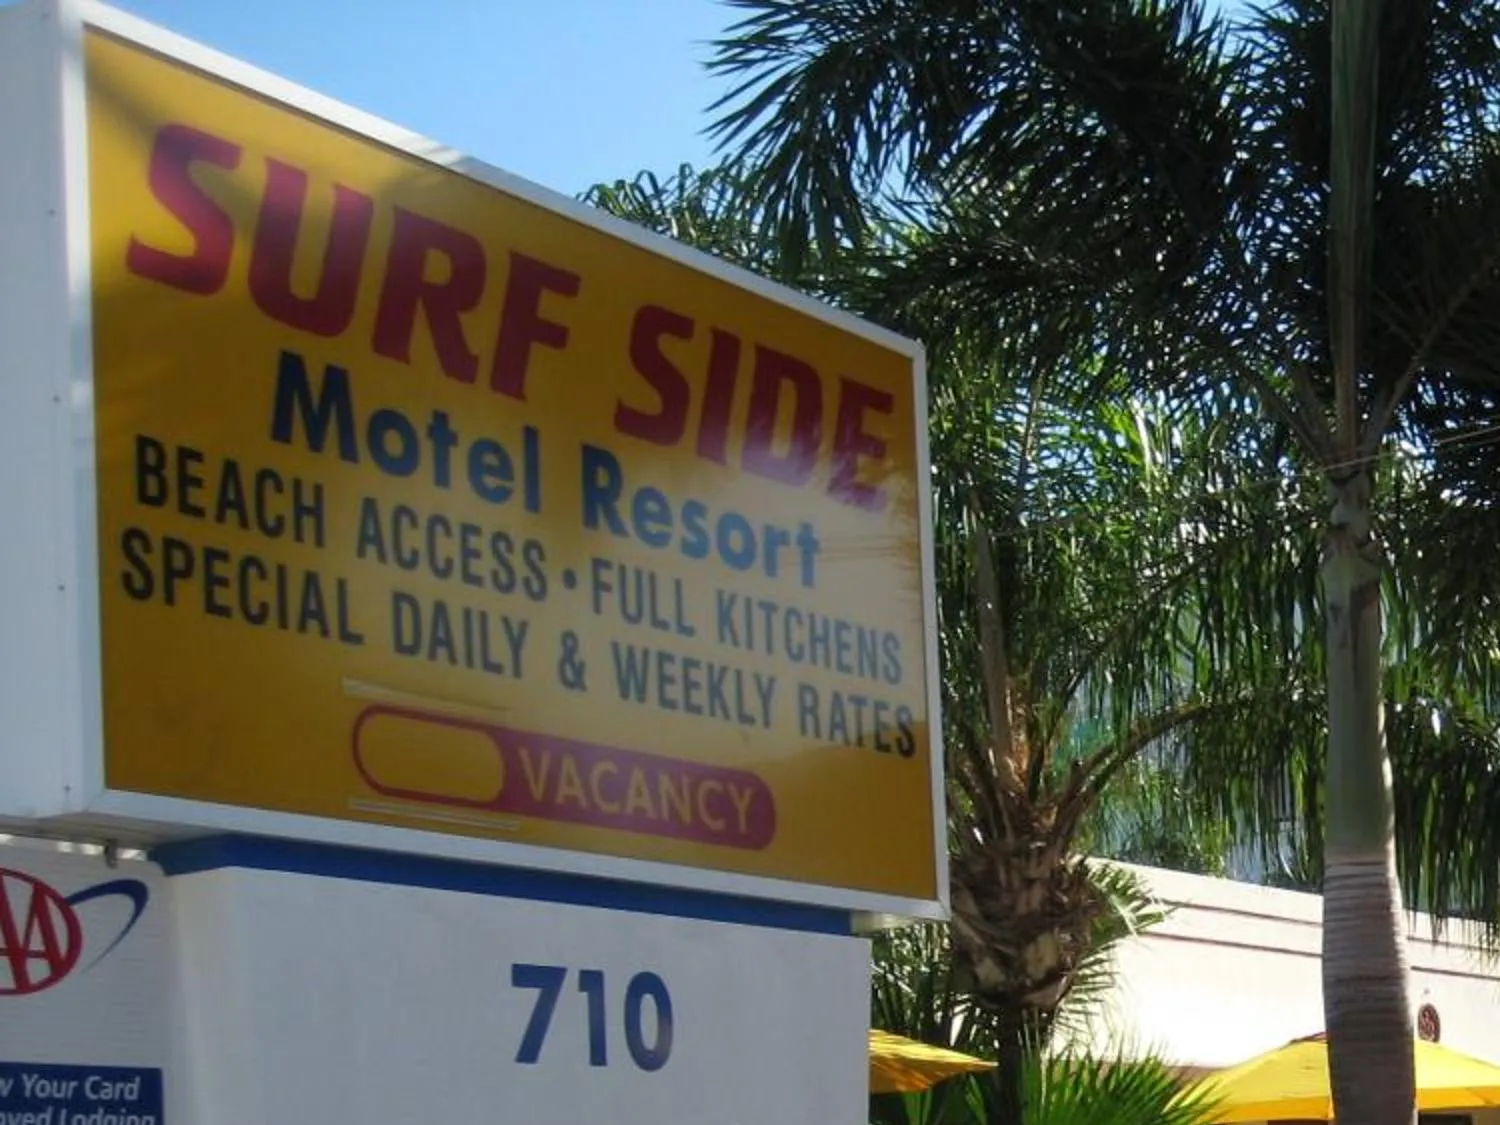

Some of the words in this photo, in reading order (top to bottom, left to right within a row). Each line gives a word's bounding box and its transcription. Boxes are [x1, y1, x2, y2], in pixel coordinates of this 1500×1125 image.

[125, 122, 581, 402] SURF
[613, 303, 894, 513] SIDE
[136, 433, 325, 548] BEACH
[356, 497, 547, 602] ACCESS
[590, 557, 696, 638] FULL
[715, 589, 902, 686] KITCHENS
[271, 349, 542, 514] Motel
[580, 442, 821, 588] Resort
[121, 527, 364, 647] SPECIAL
[391, 590, 528, 679] DAILY
[558, 629, 587, 692] &
[611, 641, 776, 729] WEEKLY
[798, 681, 915, 759] RATES
[519, 746, 757, 834] VACANCY
[21, 1073, 79, 1099] Your
[84, 1075, 141, 1101] Card
[511, 963, 673, 1072] 710
